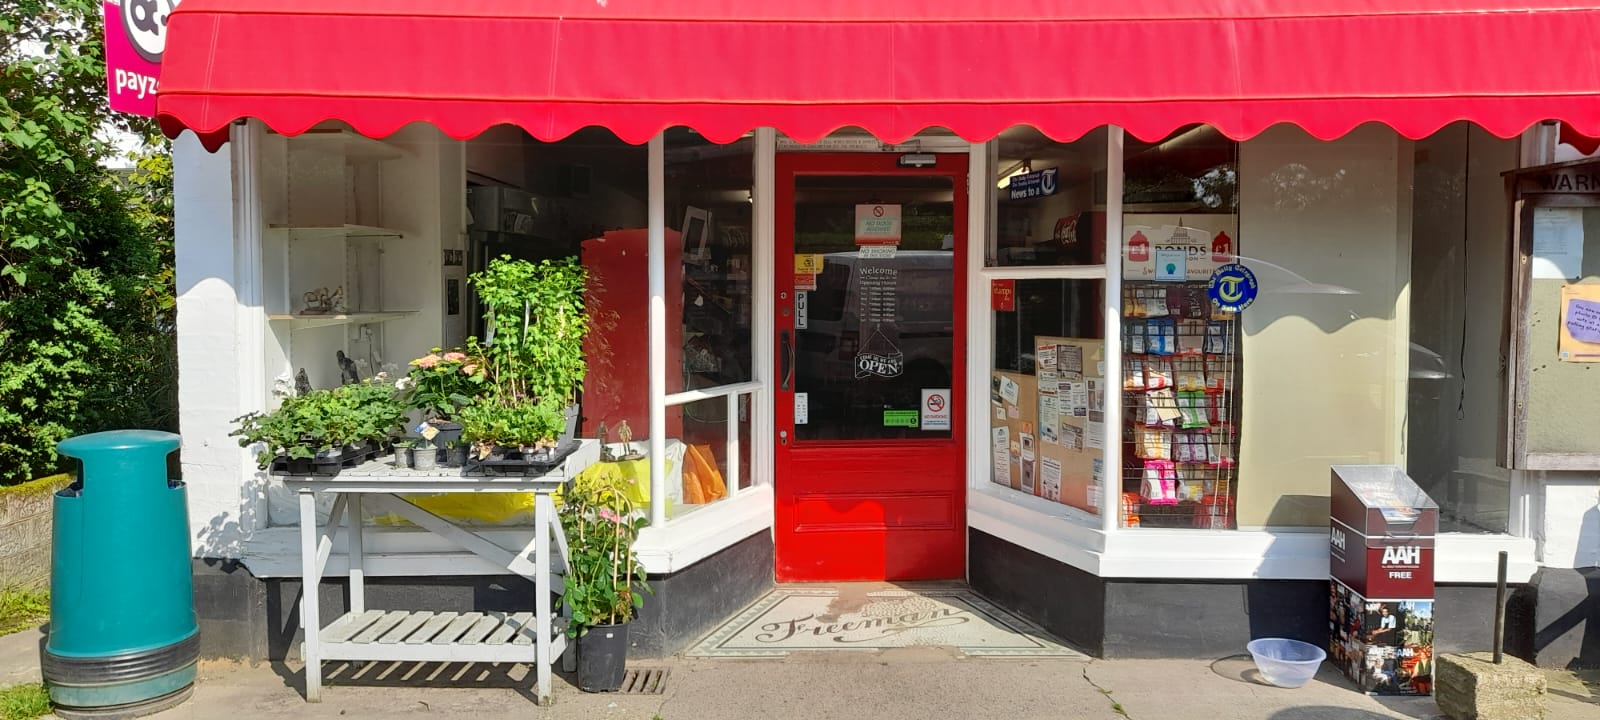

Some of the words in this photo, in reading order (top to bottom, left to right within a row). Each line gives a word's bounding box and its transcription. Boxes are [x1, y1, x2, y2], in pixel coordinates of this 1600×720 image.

[115, 68, 160, 99] payz
[1011, 188, 1027, 200] News
[1028, 186, 1035, 197] to
[1035, 187, 1040, 196] a
[1132, 243, 1146, 255] £1
[1215, 243, 1230, 256] £1
[859, 266, 898, 276] Welcome
[1216, 265, 1233, 276] Daily
[1235, 265, 1256, 289] Telegraph
[1219, 275, 1245, 303] T
[1212, 297, 1221, 307] On
[1221, 304, 1238, 312] Sale
[1238, 298, 1254, 311] Here
[859, 359, 898, 375] OPEN
[1331, 526, 1346, 551] AAH
[1381, 545, 1420, 564] AAH
[1389, 571, 1413, 579] FREE
[755, 608, 971, 643] Freeman
